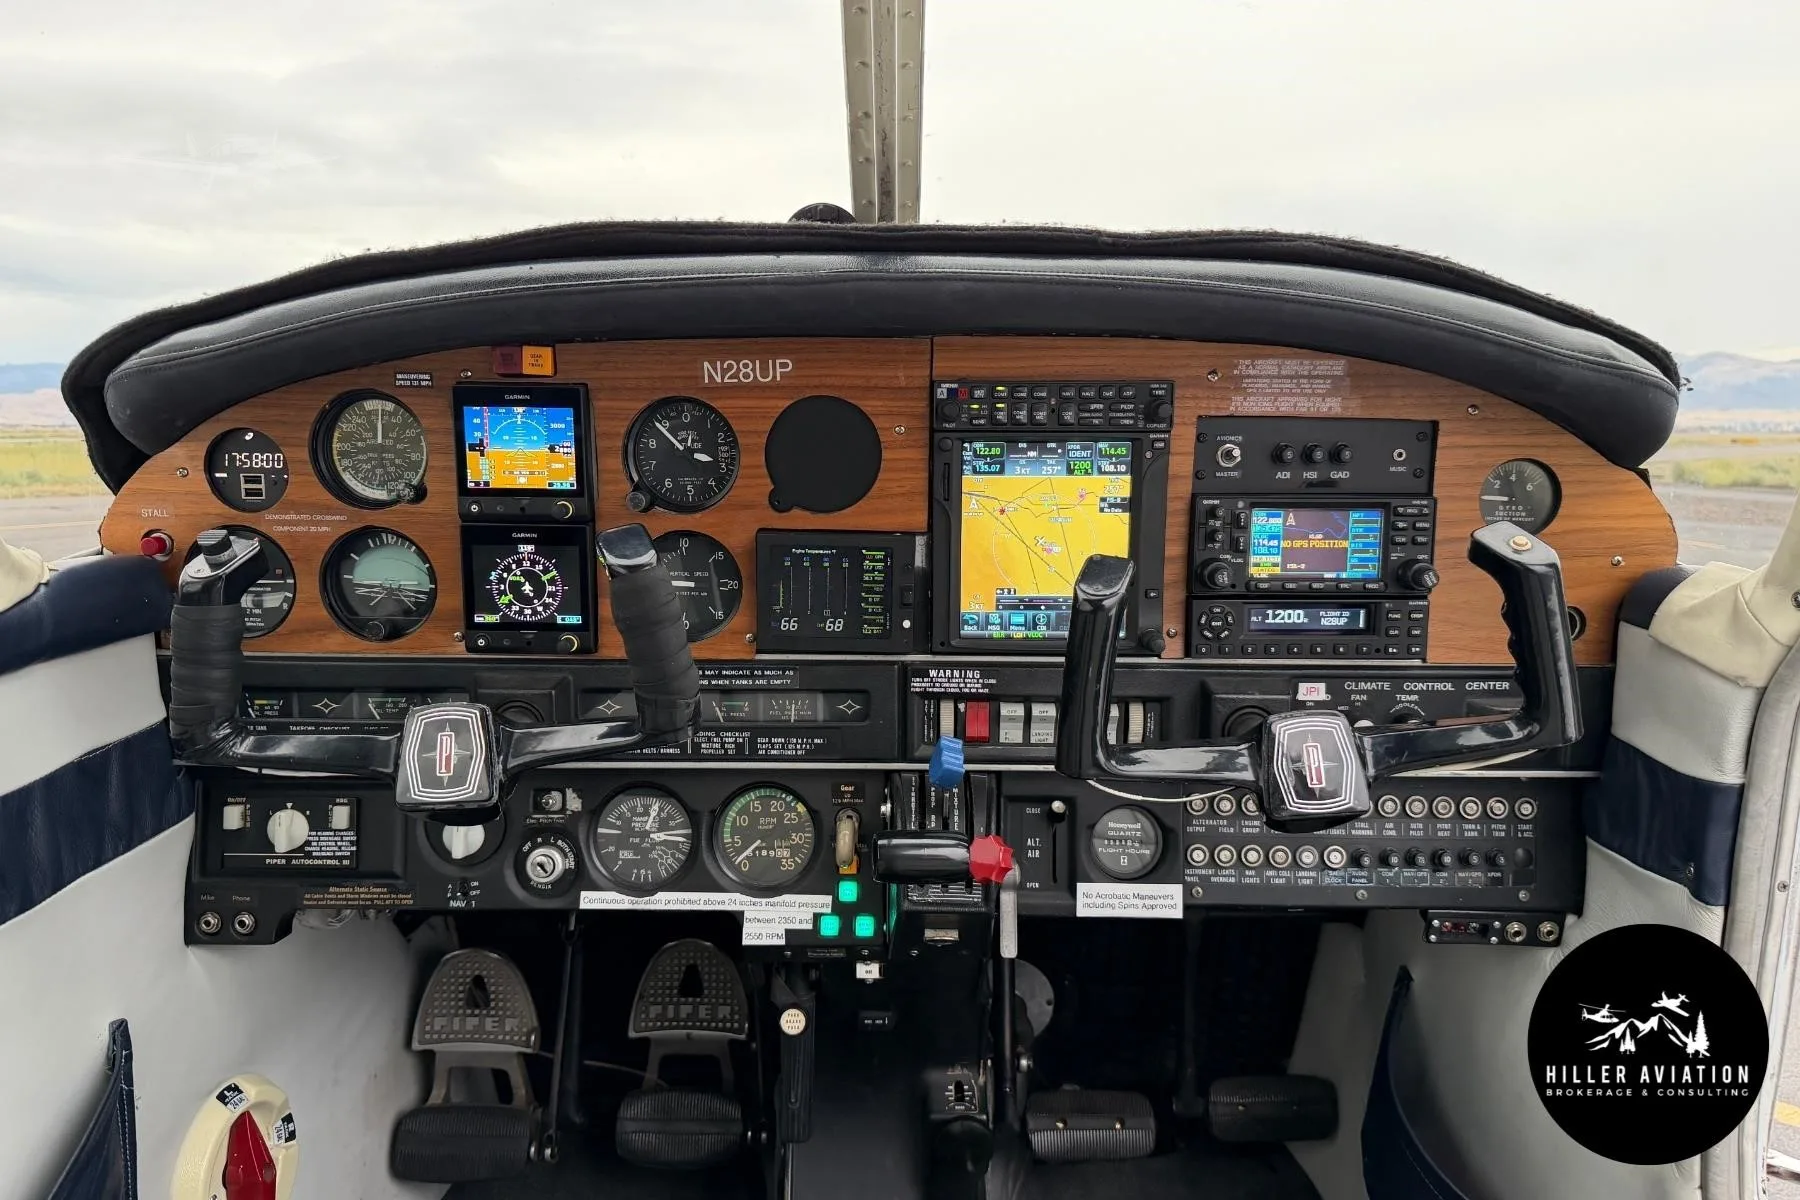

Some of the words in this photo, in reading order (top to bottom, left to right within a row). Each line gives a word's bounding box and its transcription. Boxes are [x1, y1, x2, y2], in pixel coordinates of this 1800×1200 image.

[703, 359, 793, 384] N28UP
[682, 412, 690, 422] 0
[661, 420, 670, 430] 9
[405, 429, 416, 437] 60
[717, 432, 726, 443] 2
[648, 438, 657, 449] 8
[975, 447, 1001, 455] 122.80
[1068, 450, 1093, 458] IDENT
[1101, 447, 1127, 455] 114.45
[224, 452, 284, 468] 17:58:00
[410, 453, 421, 461] 80
[648, 460, 656, 470] 7
[719, 463, 727, 473] 3
[975, 464, 1001, 472] 135.07
[1069, 460, 1092, 469] 1200
[1100, 464, 1127, 472] 108.10
[1276, 471, 1291, 479] ADI
[1303, 471, 1318, 479] HSI
[1330, 471, 1350, 479] GAD
[1509, 473, 1517, 482] 4
[664, 478, 673, 488] 6
[707, 477, 716, 487] 4
[1493, 479, 1501, 489] 2
[1526, 483, 1533, 491] 6
[686, 485, 694, 495] 5
[141, 508, 169, 518] STALL
[679, 537, 689, 548] 10
[1292, 540, 1309, 548] GPS
[1309, 540, 1348, 548] POSITION
[715, 551, 724, 560] 15
[727, 580, 739, 589] 20
[715, 611, 724, 620] 15
[1264, 609, 1304, 624] 1200
[780, 617, 799, 631] 66
[825, 618, 844, 632] 68
[1320, 617, 1348, 625] N28UP
[928, 669, 981, 678] WARNING
[1344, 681, 1392, 690] CLIMATE
[1403, 682, 1455, 691] CONTROL
[1465, 682, 1510, 691] CENTER
[1302, 686, 1320, 697] JPI
[750, 800, 762, 812] 15
[770, 800, 785, 812] 20
[736, 815, 749, 826] 10
[759, 817, 777, 825] RPM
[783, 812, 799, 824] 25
[1108, 821, 1141, 829] Honeywell
[734, 835, 742, 847] 5
[789, 832, 805, 844] 30
[1026, 838, 1042, 847] ALT.
[522, 841, 532, 852] OFF
[1027, 849, 1040, 858] AIR
[780, 858, 795, 870] 35
[1472, 855, 1479, 863] 5
[741, 860, 749, 871] 0
[232, 895, 251, 903] Phone
[1082, 891, 1094, 899] No
[1095, 891, 1130, 900] Acrobatic
[1132, 892, 1174, 900] Maneuvers
[449, 900, 467, 908] NAV
[582, 896, 626, 905] Continuous
[627, 897, 663, 907] operation
[664, 897, 701, 907] prohibited
[702, 897, 726, 906] above
[727, 897, 737, 906] 24
[739, 899, 763, 907] inches
[765, 900, 796, 908] manifold
[798, 901, 831, 911] pressure
[1082, 901, 1116, 910] including
[1117, 901, 1140, 910] Spins
[1141, 902, 1177, 911] Approved
[744, 916, 776, 924] between
[777, 916, 797, 925] 2350
[798, 916, 813, 925] and
[744, 932, 763, 941] 2550
[765, 932, 784, 940] RPM
